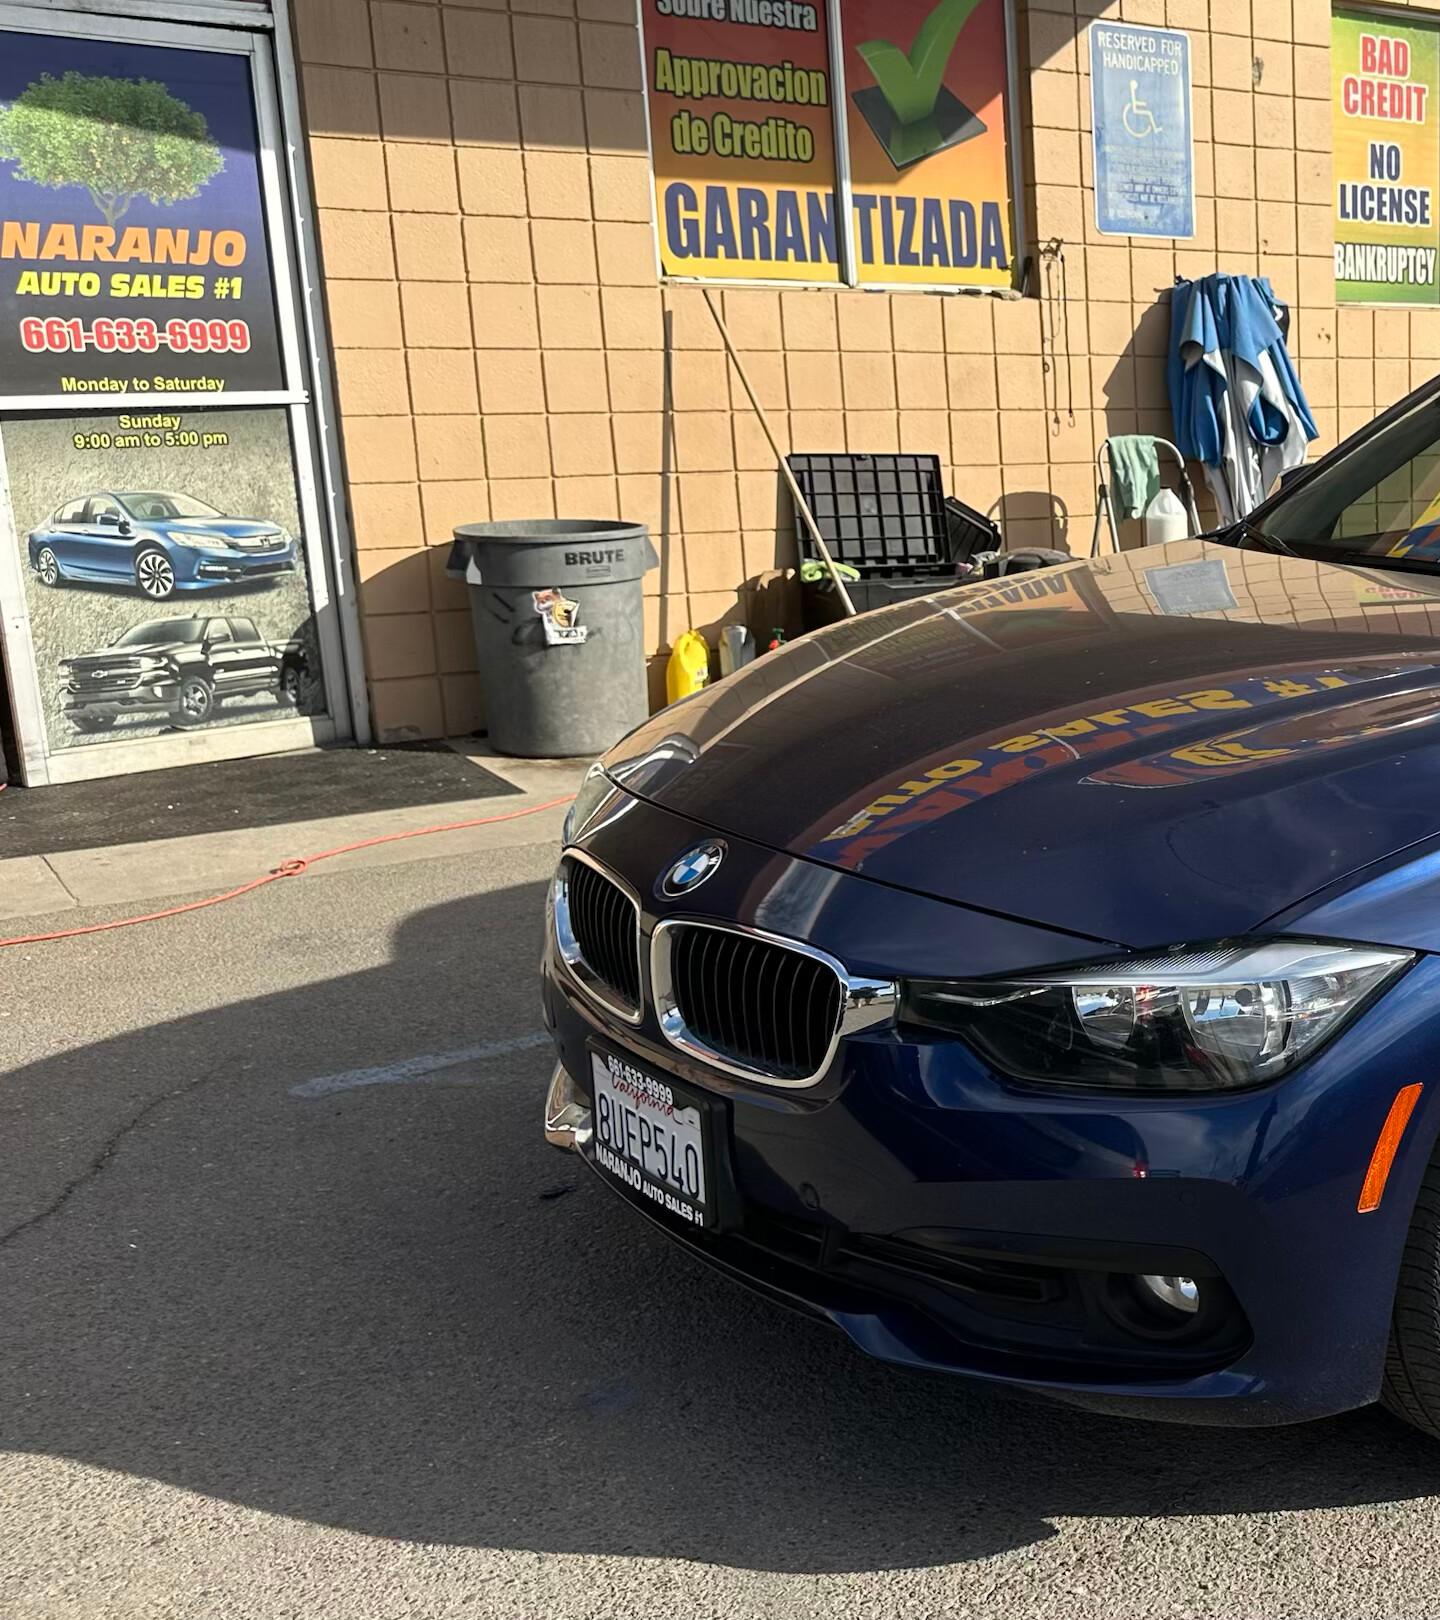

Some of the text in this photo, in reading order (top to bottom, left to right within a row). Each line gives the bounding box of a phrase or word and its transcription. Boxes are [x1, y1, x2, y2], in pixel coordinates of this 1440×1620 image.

[729, 0, 818, 31] Nuestra
[1097, 31, 1183, 56] RESERVED FOR
[1103, 51, 1180, 75] HANDICAPPED
[1361, 35, 1409, 78] BAD
[655, 48, 828, 106] Approvacion
[1343, 76, 1427, 122] CREDIT
[672, 110, 815, 163] de Credito
[1370, 143, 1401, 181] NO
[1339, 183, 1430, 225] LICENSE
[1, 221, 247, 267] NARANJO
[664, 182, 1008, 270] GARANTIZADA
[1334, 241, 1437, 285] BANKRUPTCY
[15, 270, 243, 300] AUTO SALES #1
[61, 376, 225, 394] Monday to Saturday
[74, 432, 229, 449] 9:00 am to 5:00 pm
[119, 414, 181, 430] Sunday
[564, 549, 624, 566] BRUTE
[608, 1055, 673, 1106] 661-633-9999
[598, 1092, 700, 1201] 8UEP540
[595, 1141, 642, 1191] NARANJO
[642, 1180, 665, 1205] AUTO
[664, 1193, 693, 1221] SALES
